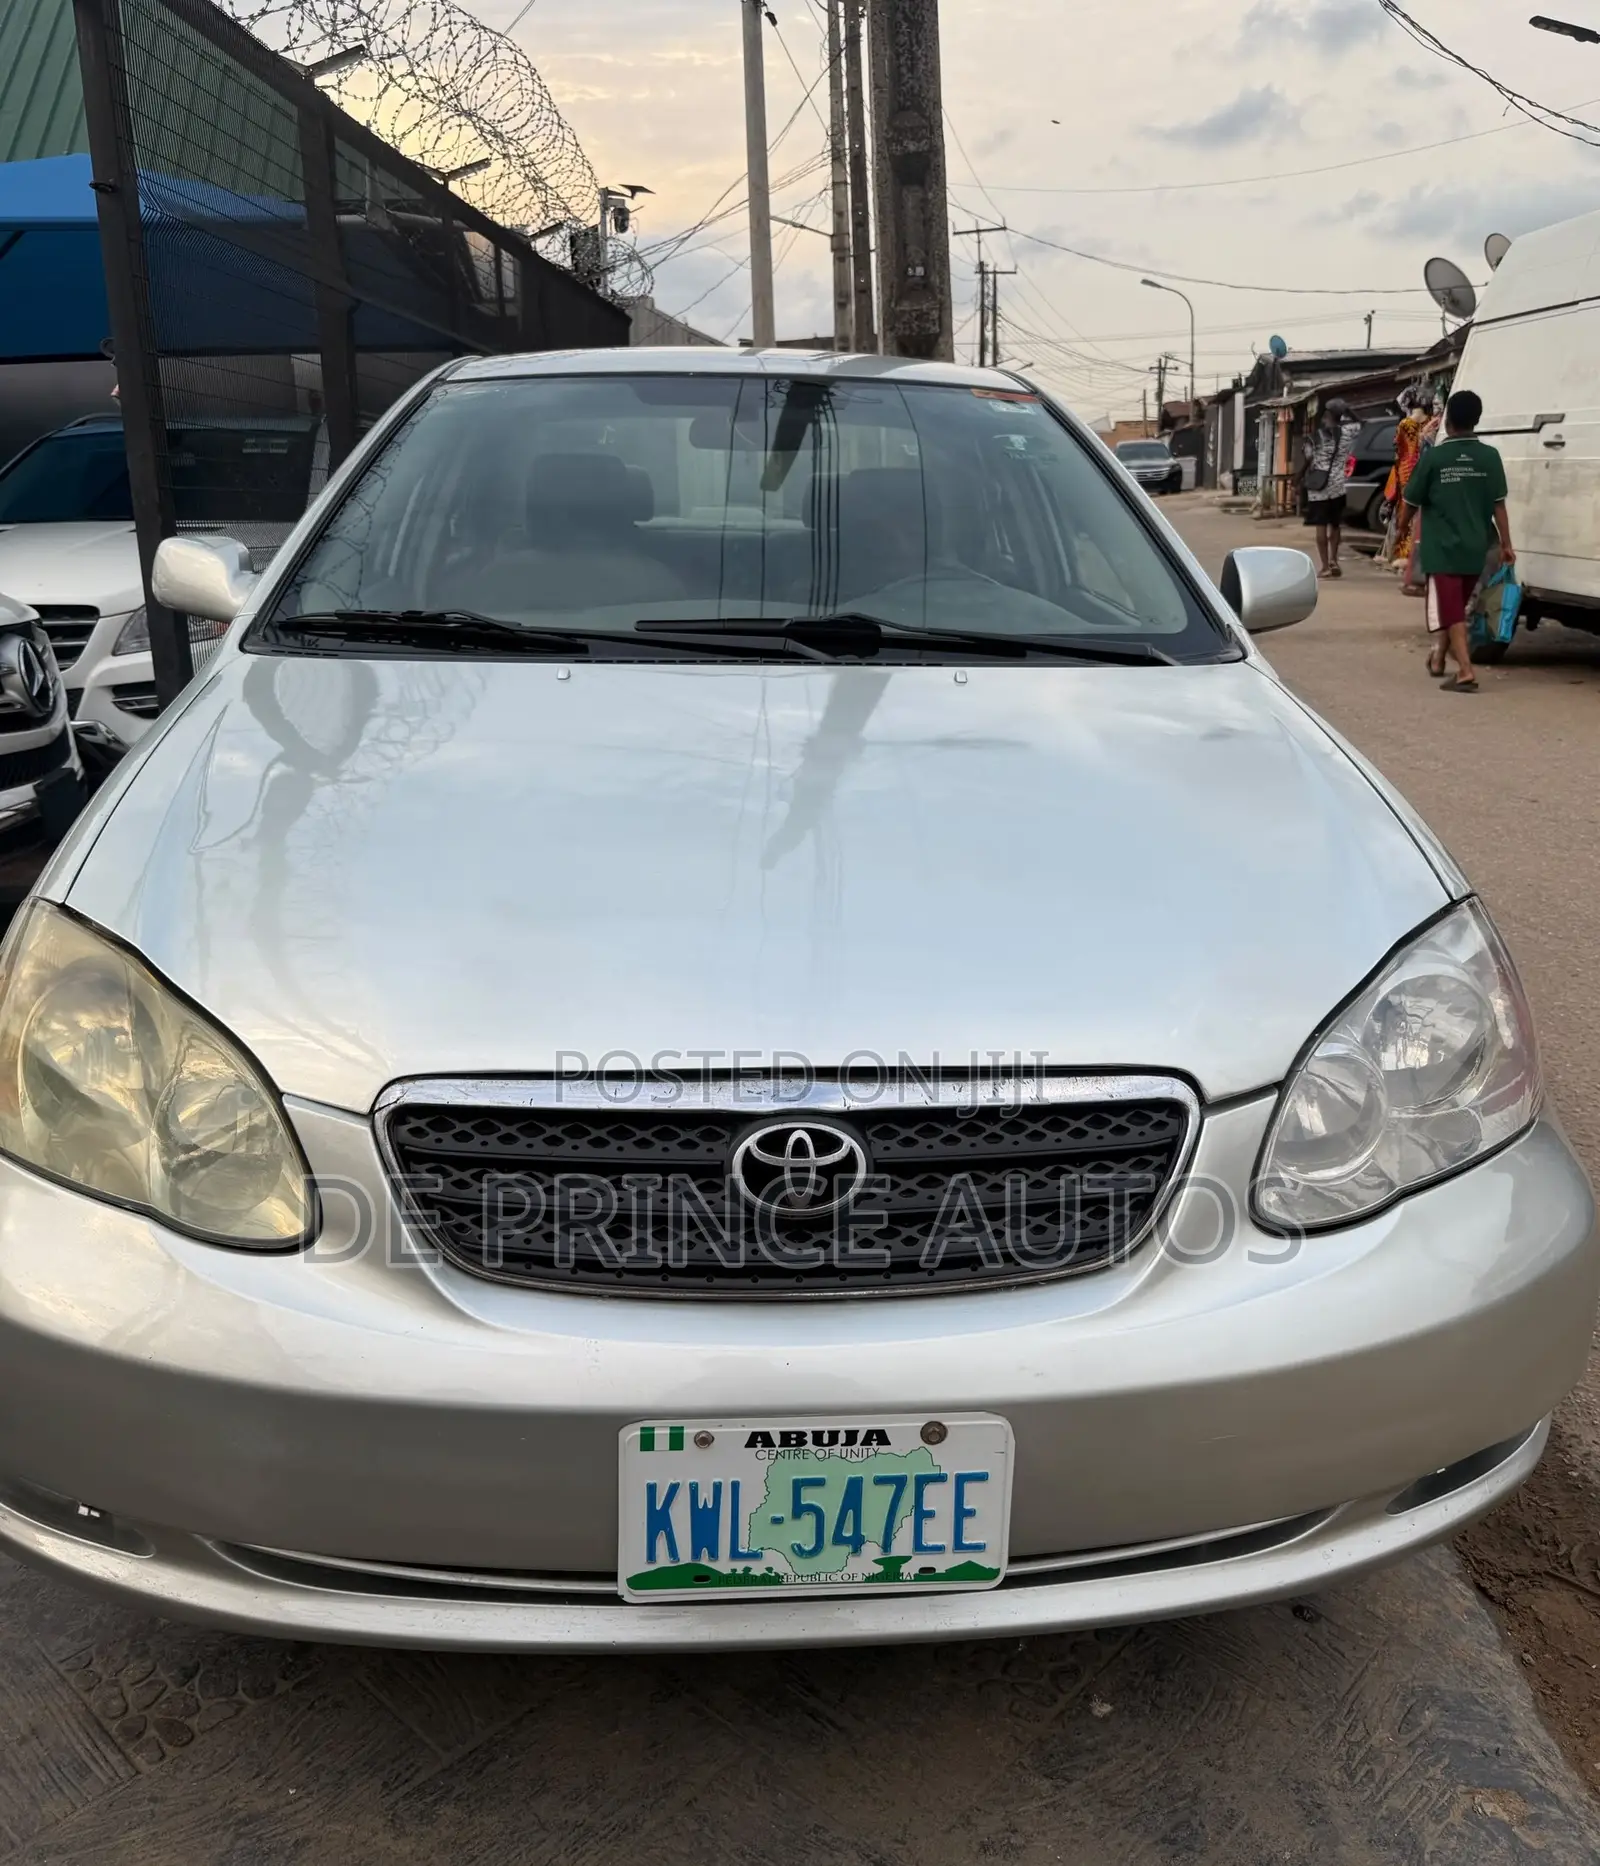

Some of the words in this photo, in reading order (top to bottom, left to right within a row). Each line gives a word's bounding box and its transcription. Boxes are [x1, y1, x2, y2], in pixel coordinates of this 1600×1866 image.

[744, 1429, 892, 1448] ABUJA
[755, 1449, 810, 1460] CENTRE
[814, 1448, 835, 1460] OF
[840, 1447, 880, 1460] UNITY
[645, 1471, 989, 1564] KWL-547EE
[778, 1573, 839, 1583] REPUBLIC
[840, 1572, 858, 1582] OF
[861, 1571, 914, 1581] NIGERIA
